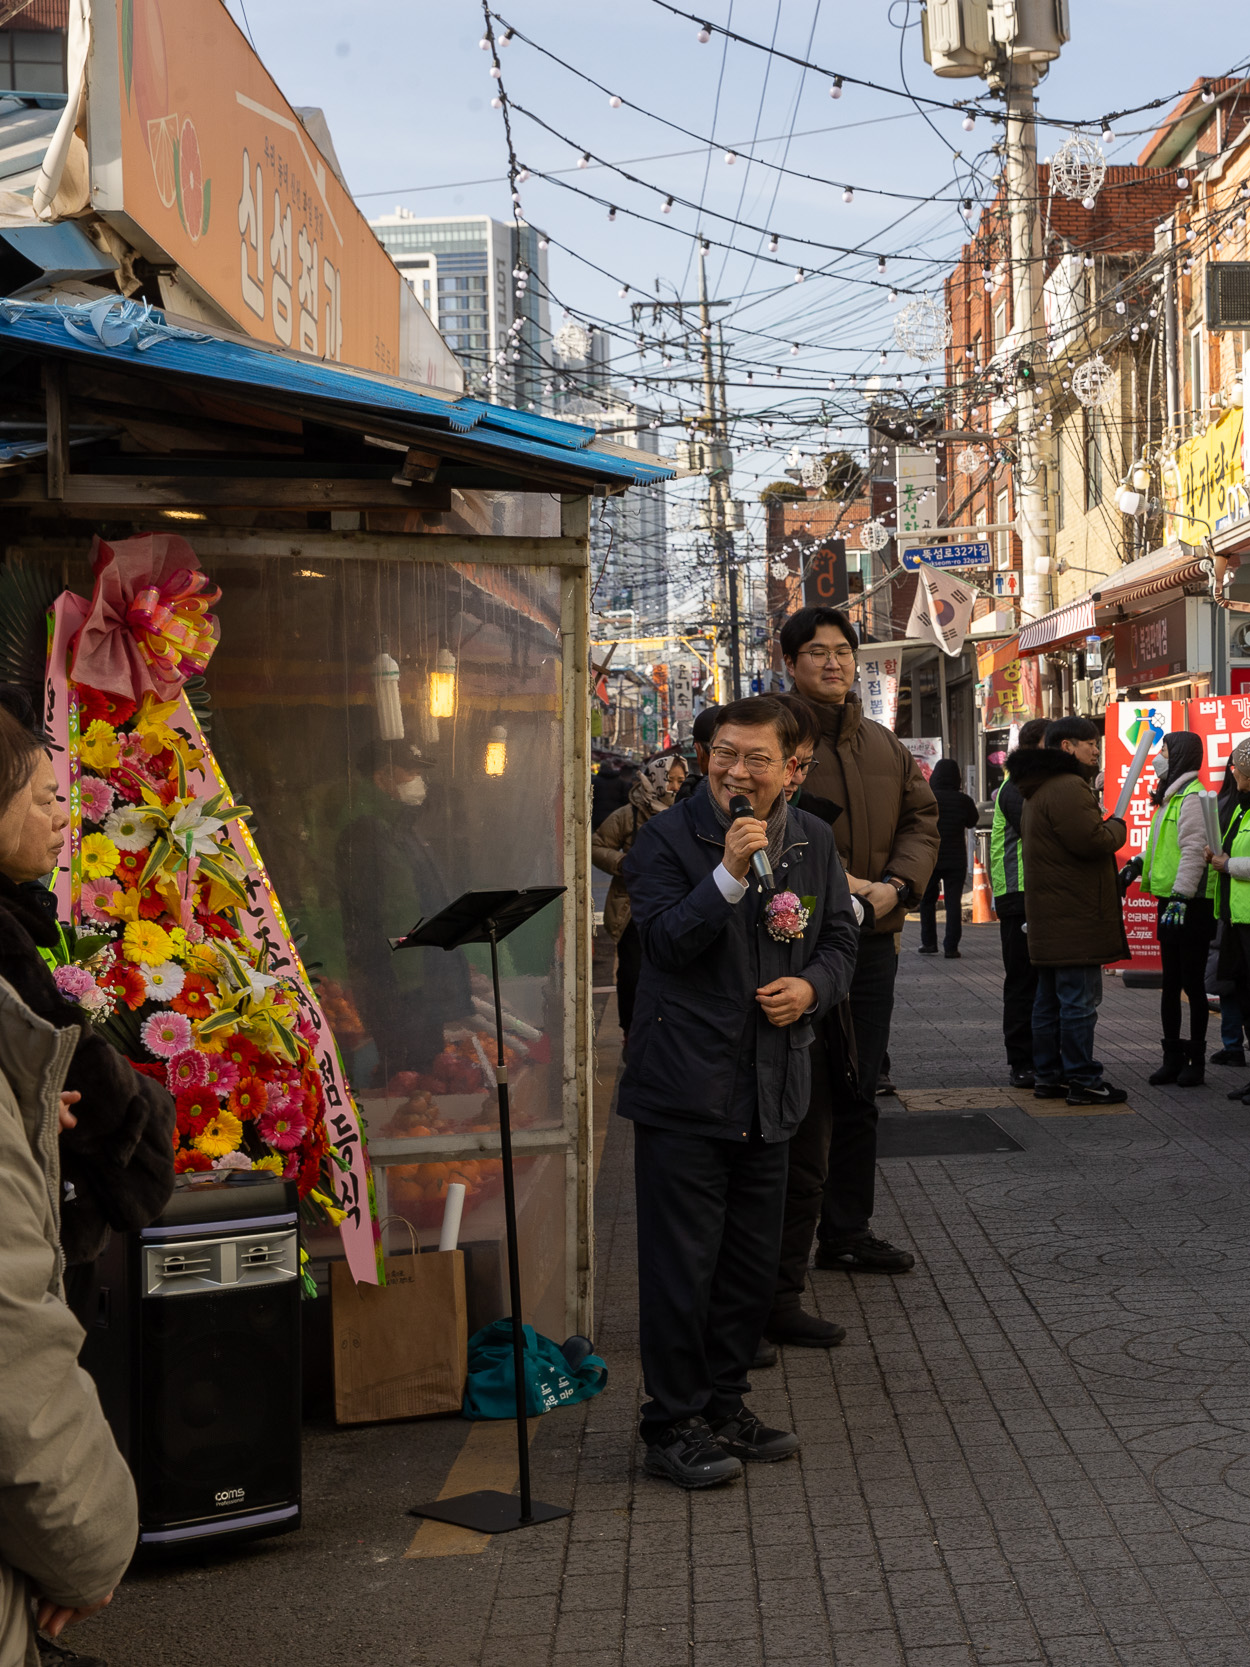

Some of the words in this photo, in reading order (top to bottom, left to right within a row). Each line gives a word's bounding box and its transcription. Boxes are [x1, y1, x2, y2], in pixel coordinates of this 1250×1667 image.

[496, 257, 508, 327] LOTTE
[922, 544, 988, 561] 뚝섬로32가길
[1140, 617, 1168, 661] 복권판매점
[215, 1487, 245, 1501] coms
